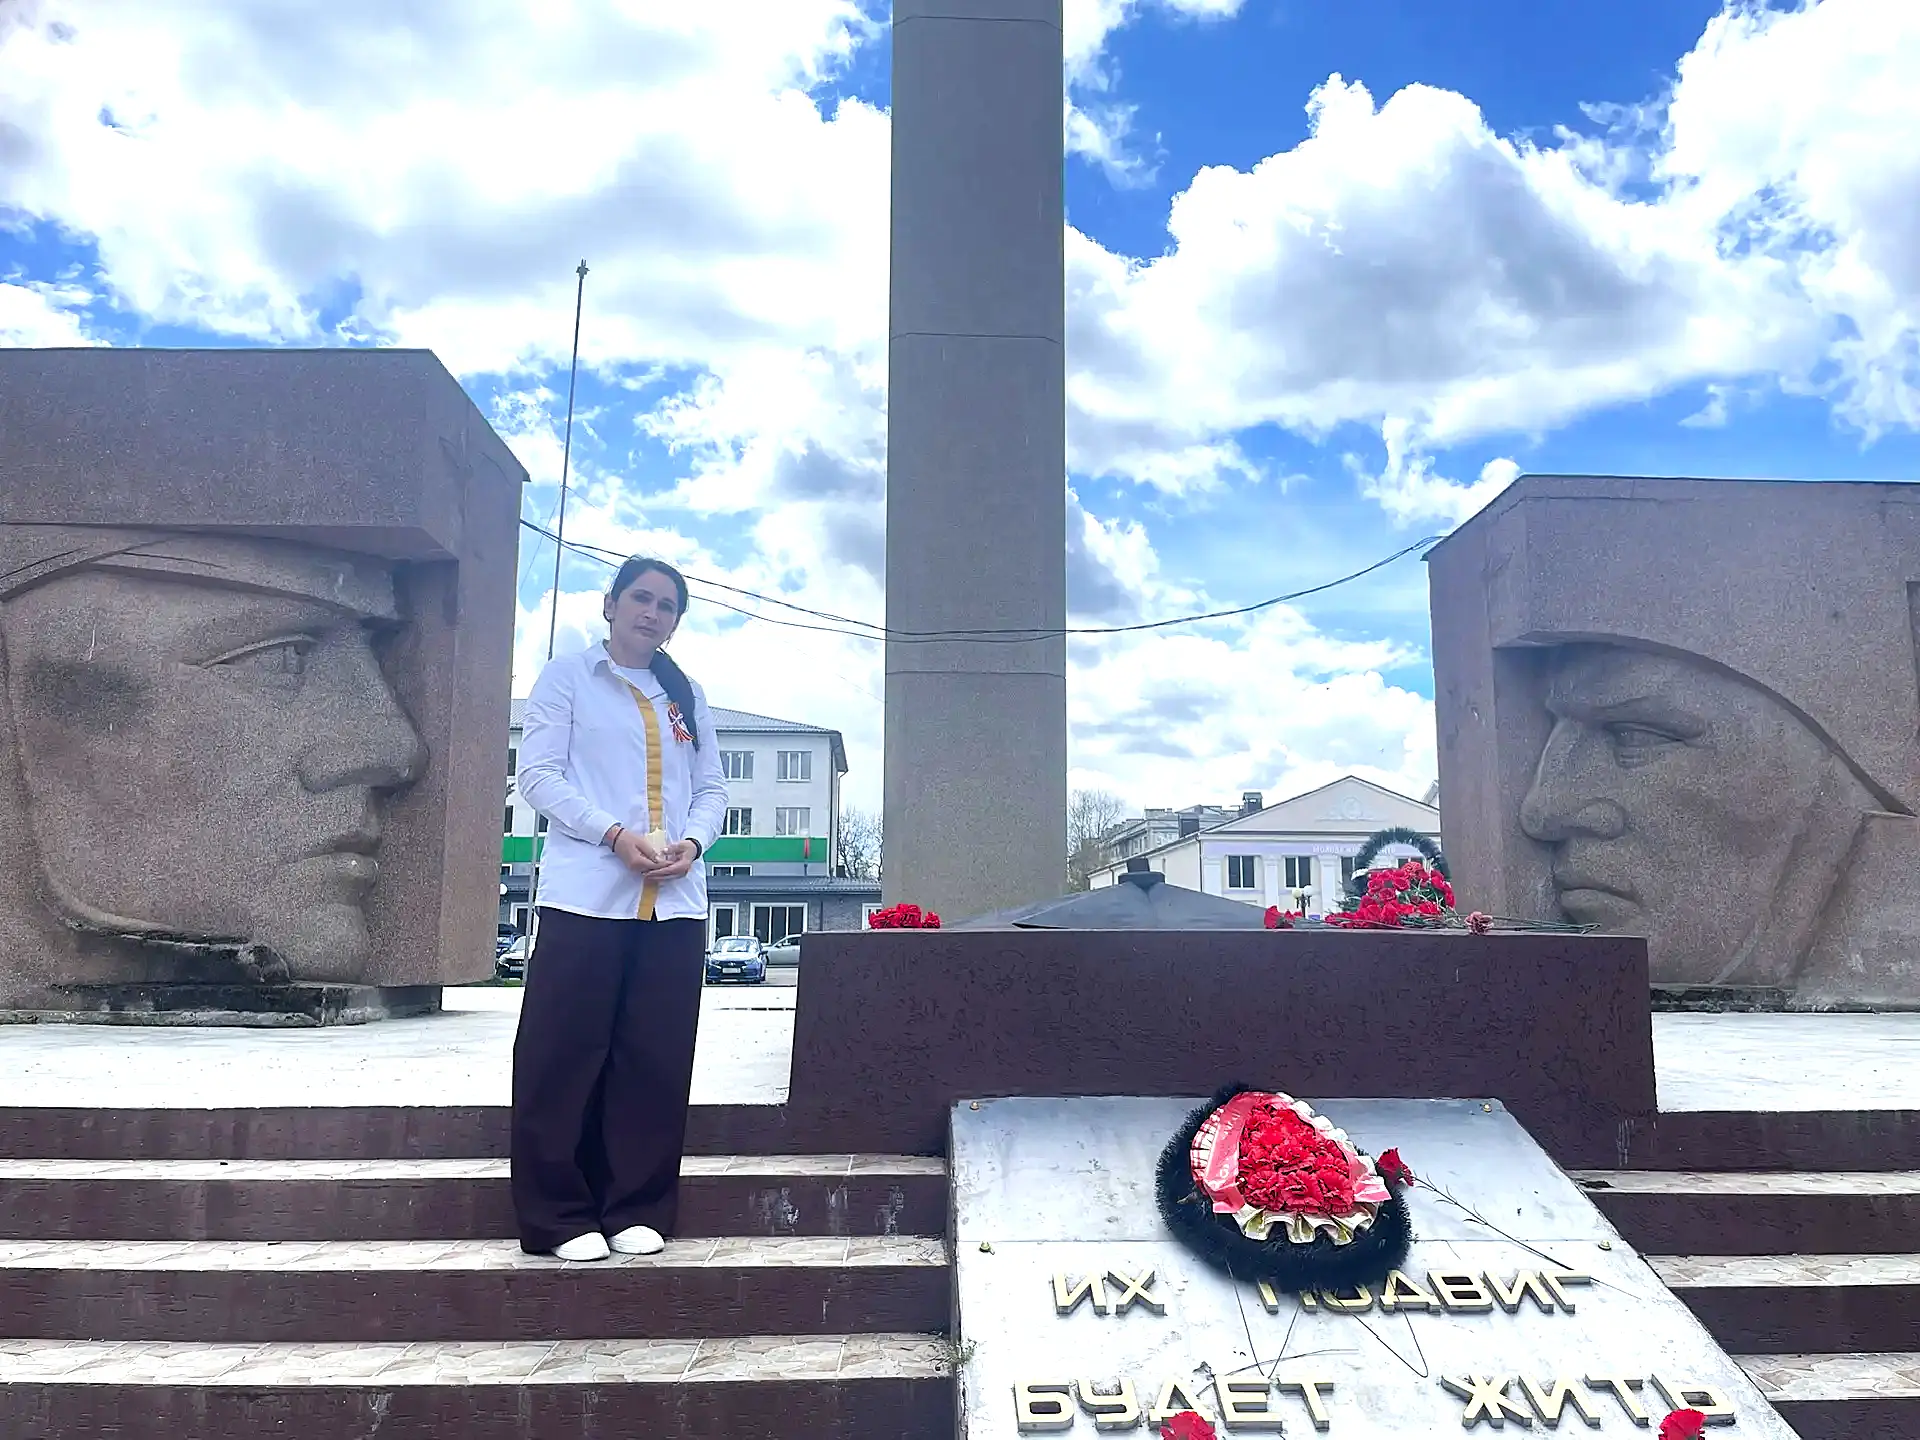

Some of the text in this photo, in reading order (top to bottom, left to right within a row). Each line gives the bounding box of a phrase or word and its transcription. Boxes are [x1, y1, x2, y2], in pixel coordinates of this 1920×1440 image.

[1052, 1268, 1165, 1315] ИХ
[1013, 1373, 1736, 1433] БУДЕТ ЖИТЬ
